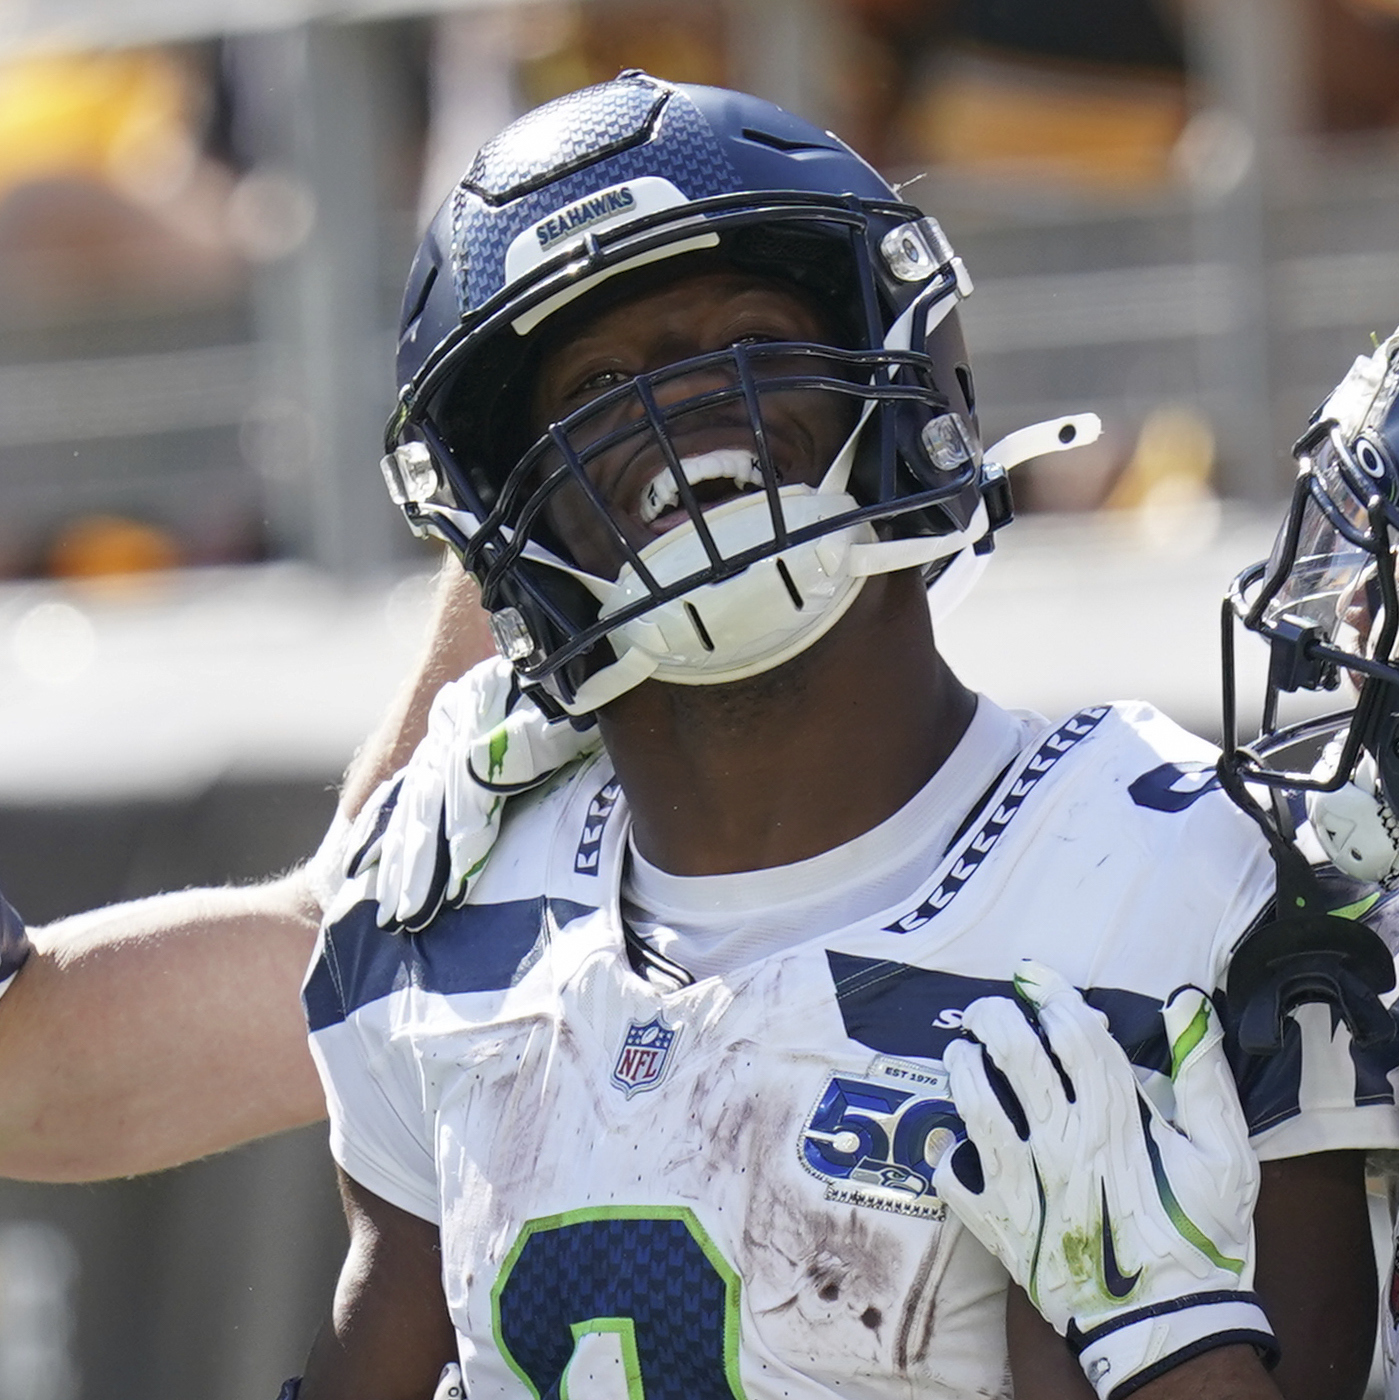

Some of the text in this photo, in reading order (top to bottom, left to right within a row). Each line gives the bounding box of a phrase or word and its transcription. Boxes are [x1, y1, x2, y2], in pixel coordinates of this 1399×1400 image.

[536, 187, 635, 246] SEAHAWKS
[618, 1048, 659, 1081] NFL
[885, 1066, 938, 1086] EST 1976
[803, 1078, 969, 1197] 50
